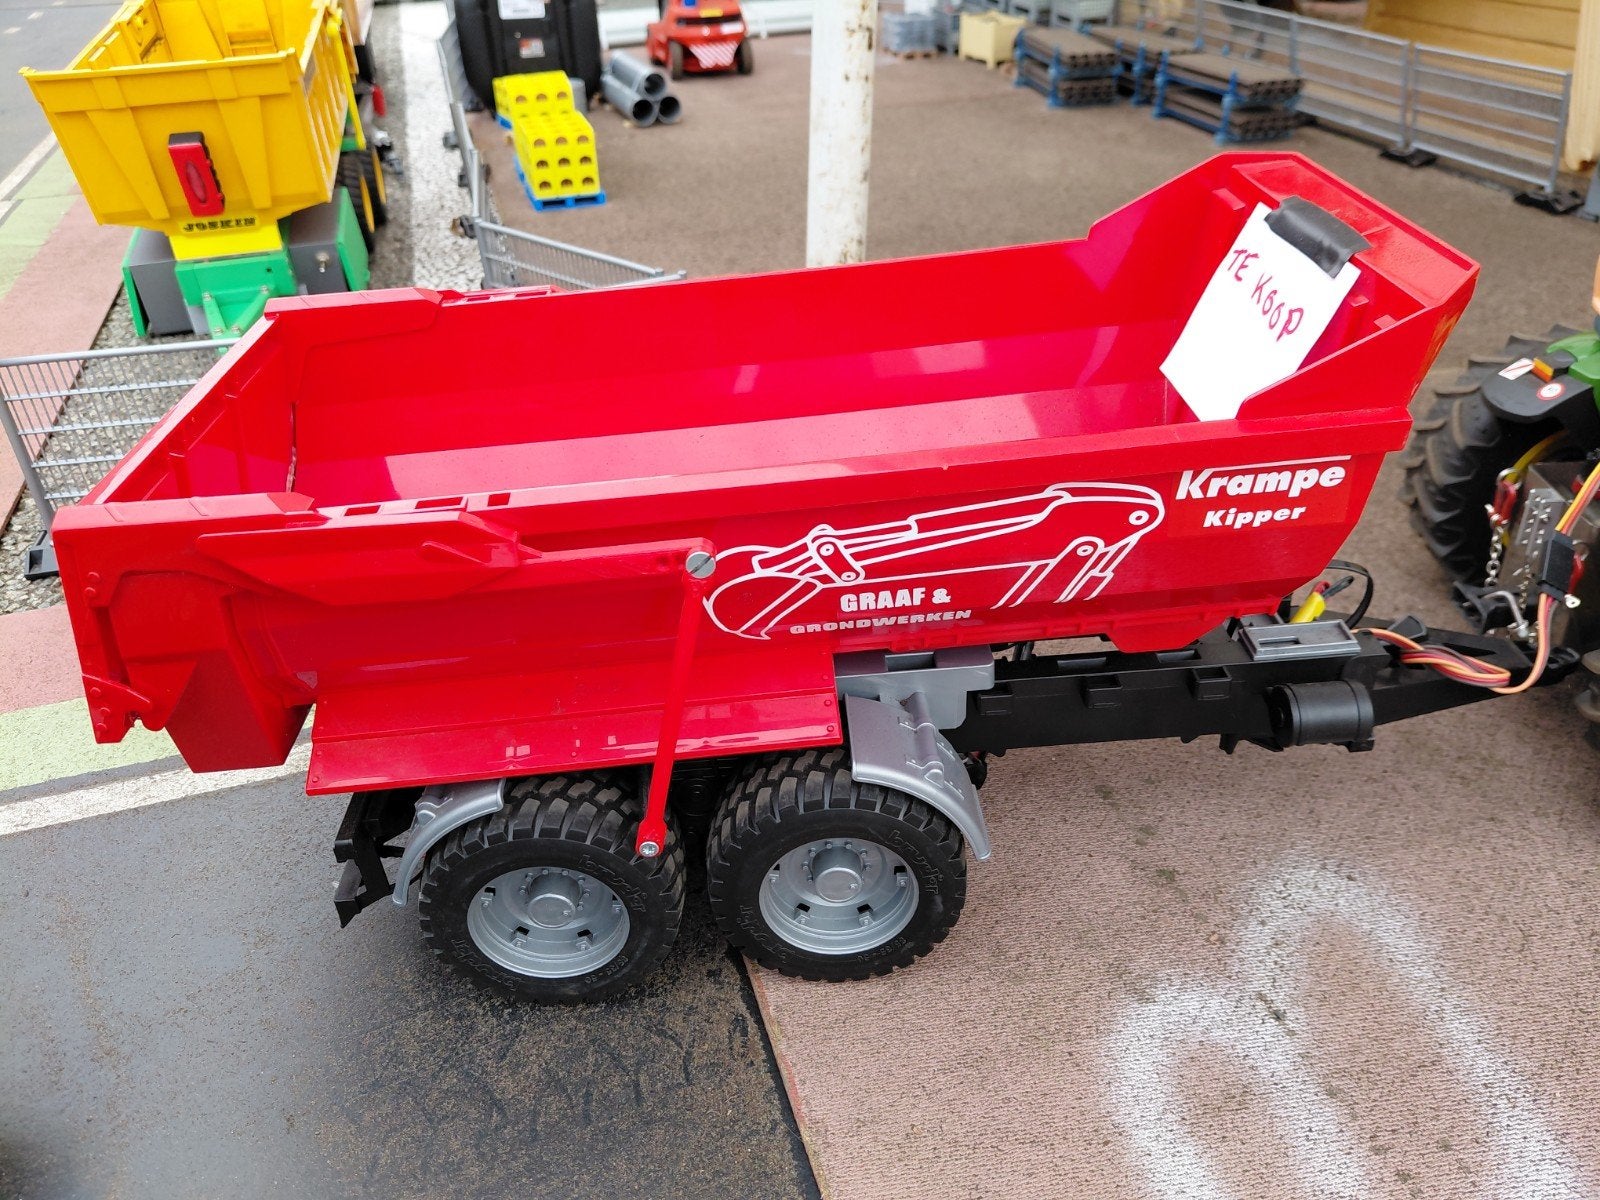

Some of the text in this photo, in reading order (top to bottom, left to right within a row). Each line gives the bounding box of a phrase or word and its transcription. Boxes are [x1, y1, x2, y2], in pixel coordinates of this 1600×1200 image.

[1227, 249, 1260, 282] TE
[1175, 460, 1348, 501] Krampe
[1203, 507, 1307, 530] Kipper
[840, 587, 952, 613] GRAAF &
[789, 609, 972, 635] GRONDWERKEN
